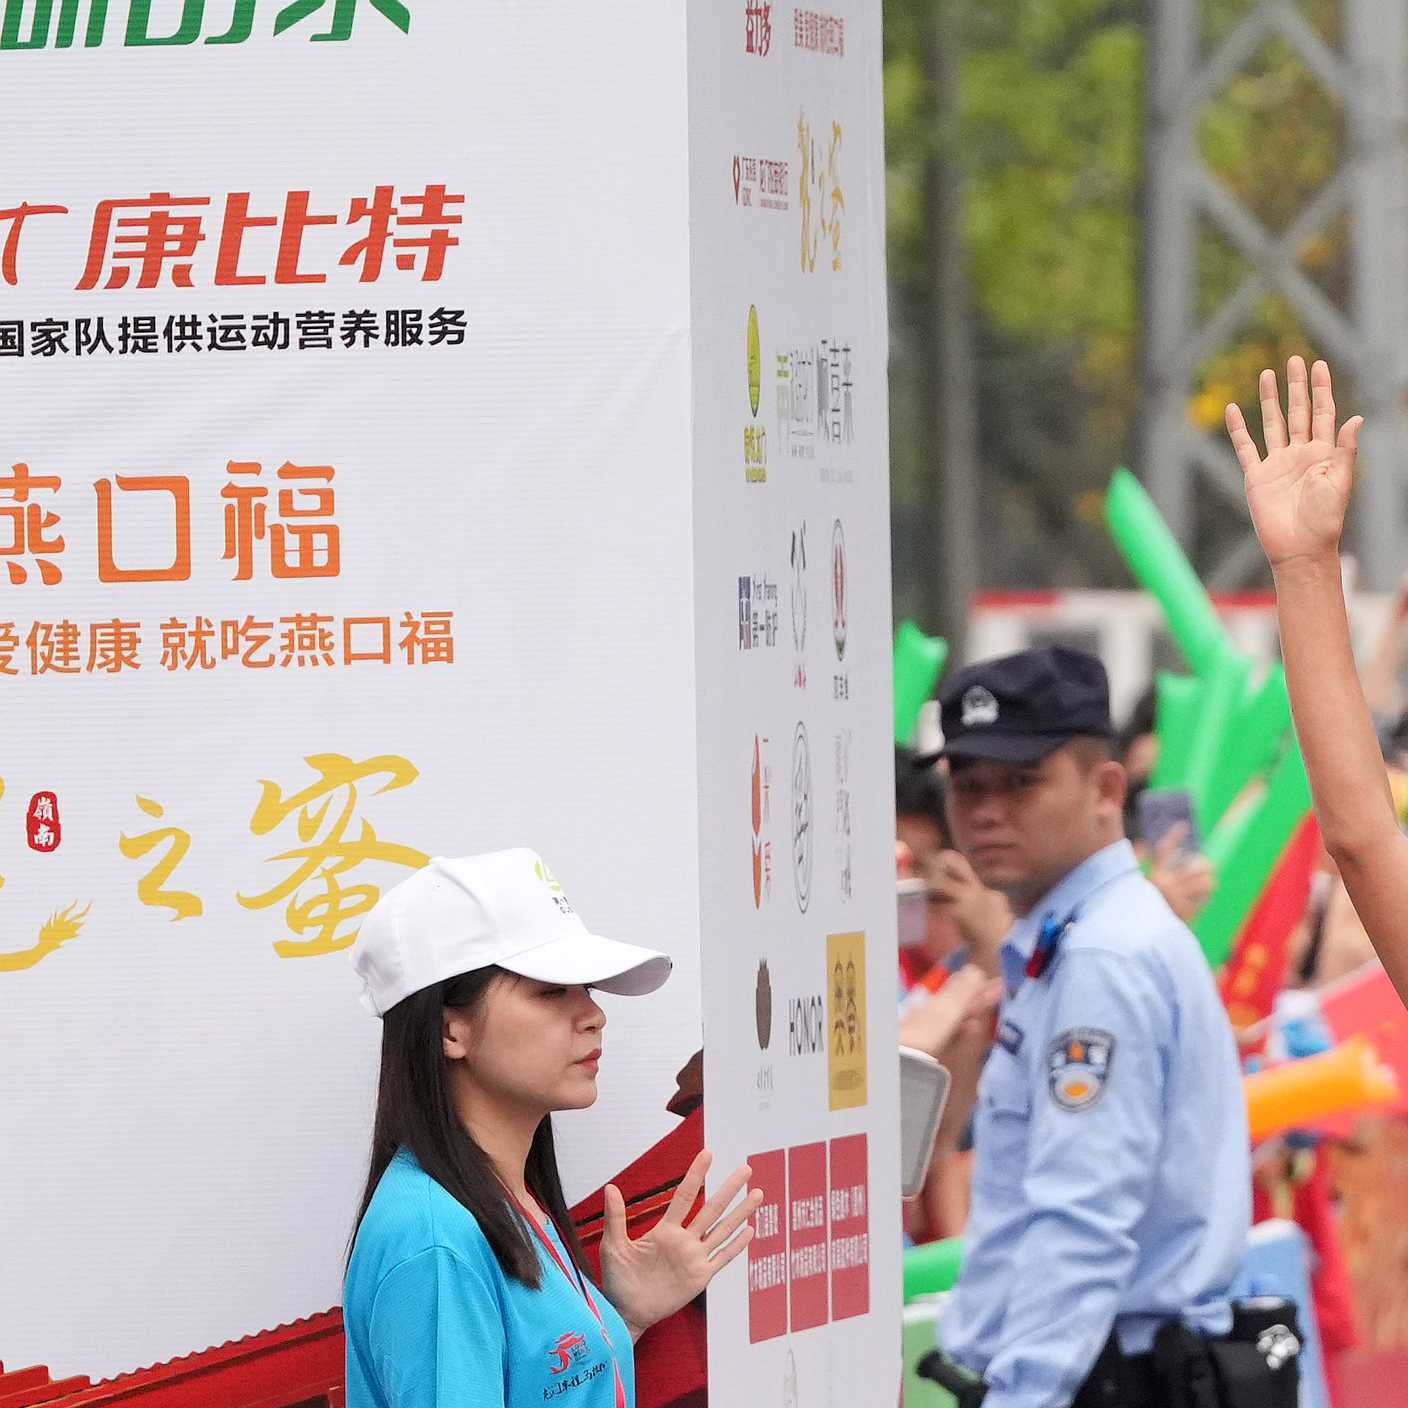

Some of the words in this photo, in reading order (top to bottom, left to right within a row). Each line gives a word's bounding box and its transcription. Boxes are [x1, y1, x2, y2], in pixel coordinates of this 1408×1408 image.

[75, 185, 466, 290] 康比特
[0, 307, 468, 357] 国家队提供运动营养服务
[0, 461, 341, 586] 燕口福
[160, 611, 455, 671] 就吃燕口福
[788, 995, 824, 1057] HONOR
